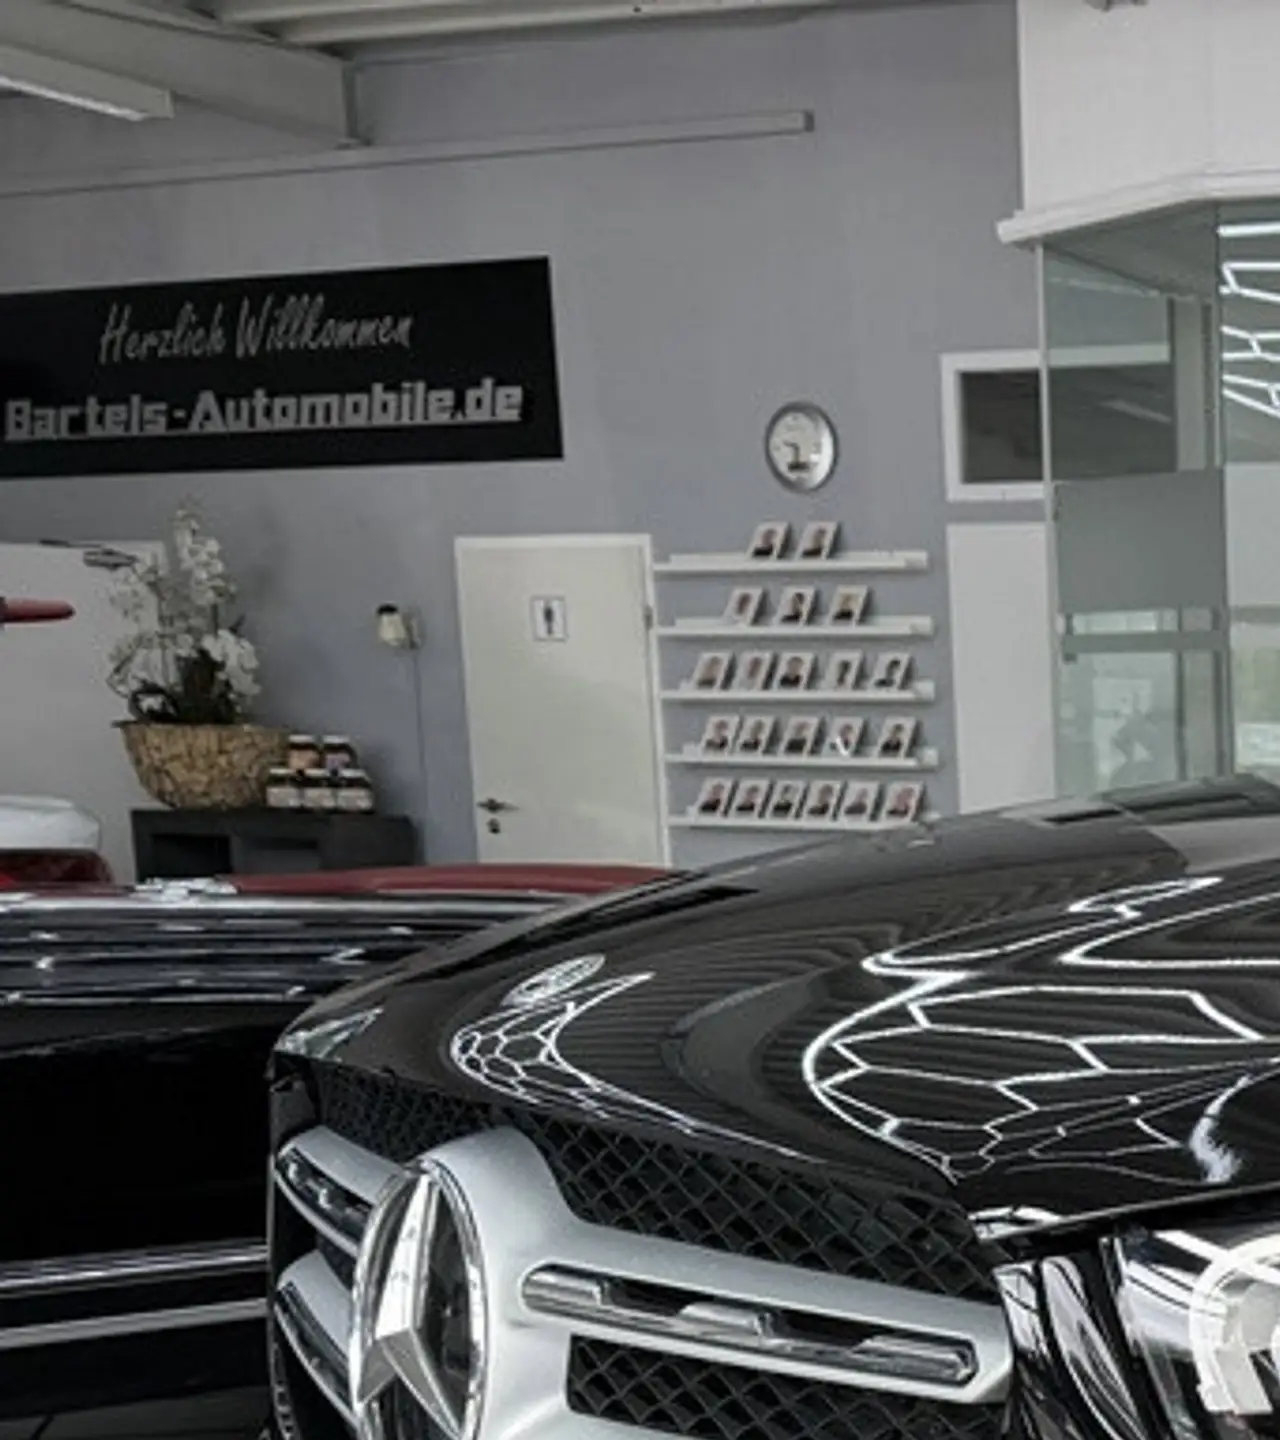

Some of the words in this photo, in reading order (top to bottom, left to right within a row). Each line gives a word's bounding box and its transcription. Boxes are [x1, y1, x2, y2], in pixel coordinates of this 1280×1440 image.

[100, 302, 226, 366] Herzlich
[236, 293, 412, 360] Willkommen
[4, 377, 523, 441] Bartels-Automobile.de
